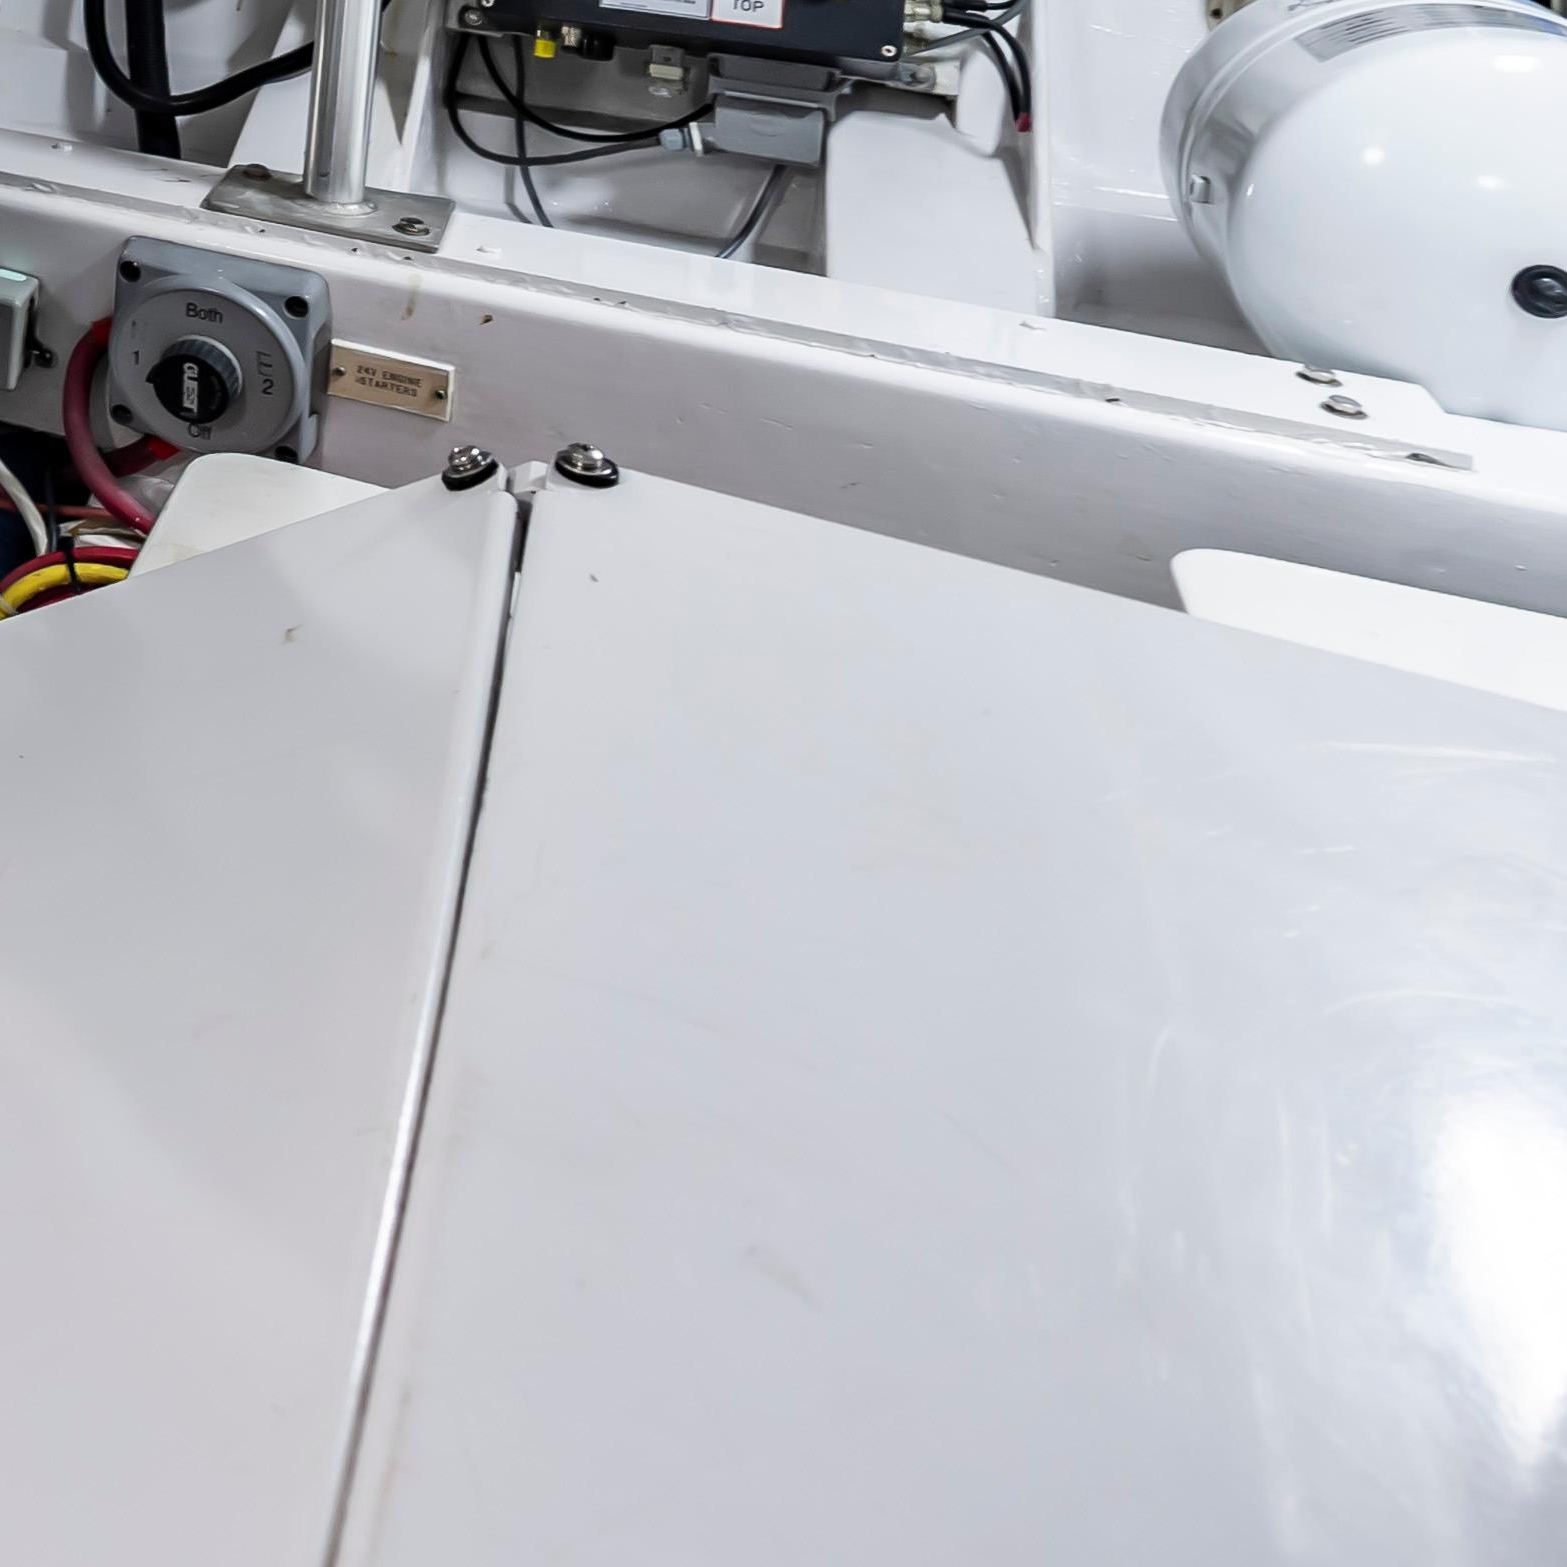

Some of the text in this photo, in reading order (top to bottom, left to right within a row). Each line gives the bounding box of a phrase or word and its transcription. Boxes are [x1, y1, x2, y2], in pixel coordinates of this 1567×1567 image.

[186, 301, 223, 325] Both
[132, 350, 140, 366] 1
[356, 365, 423, 388] 24V ENGINE
[261, 378, 275, 396] 2
